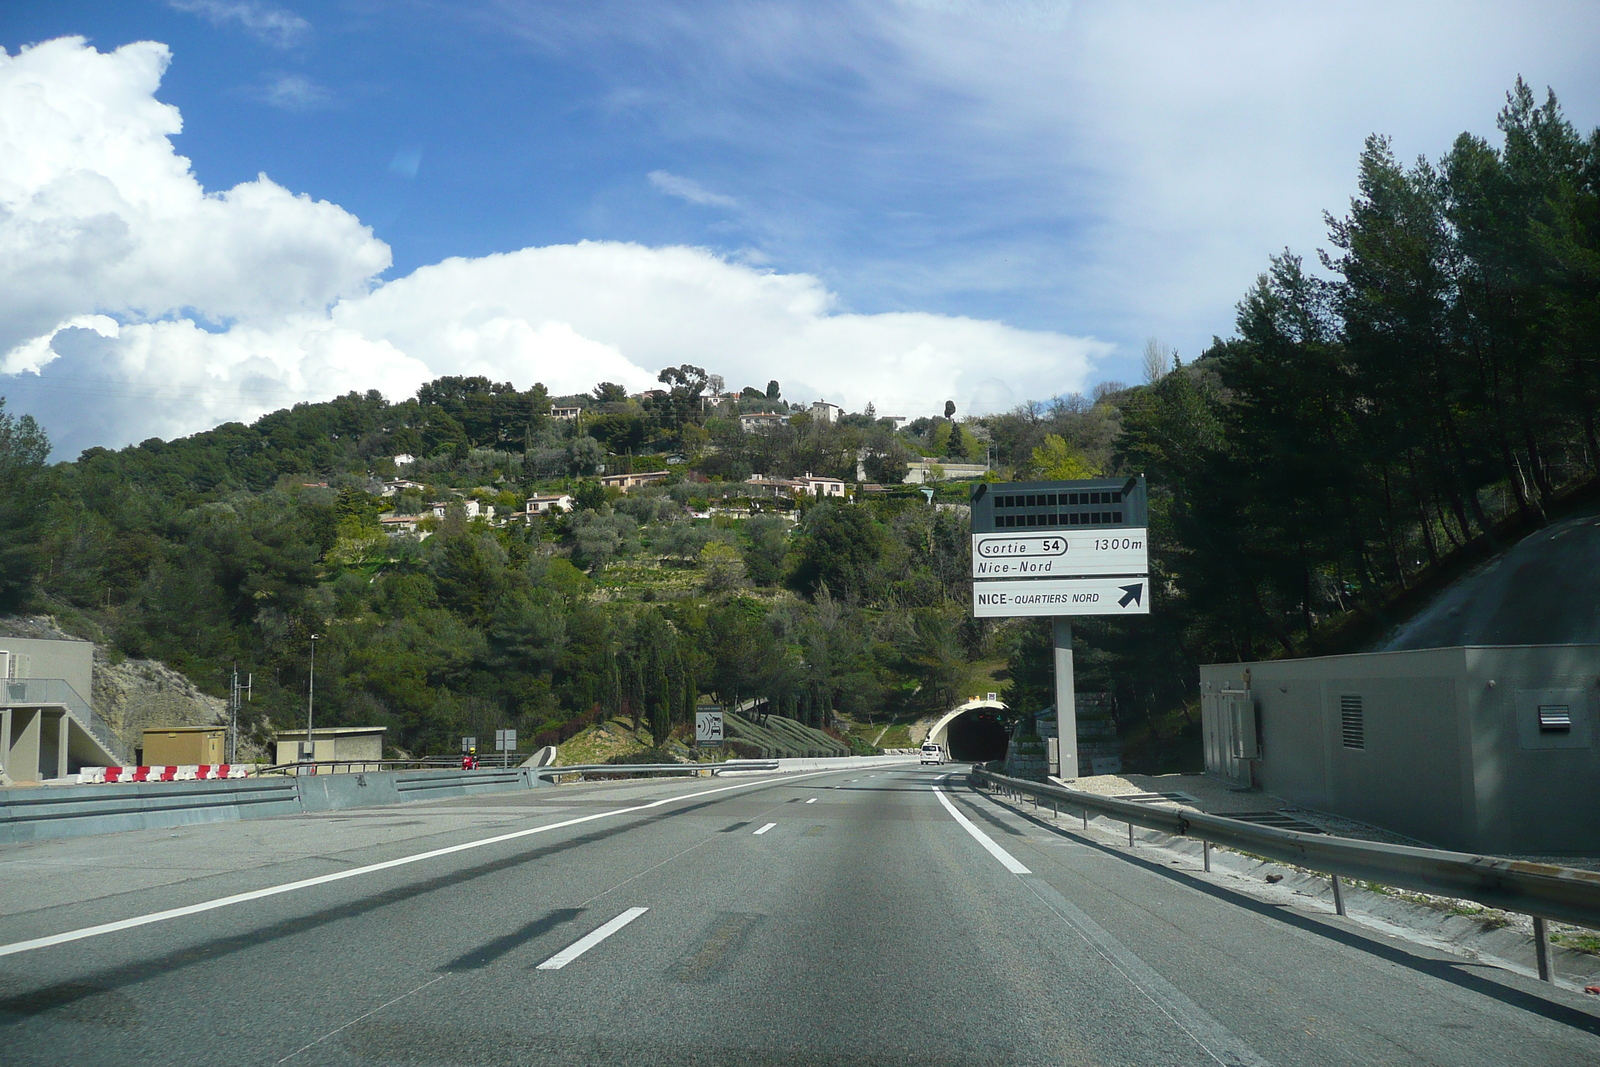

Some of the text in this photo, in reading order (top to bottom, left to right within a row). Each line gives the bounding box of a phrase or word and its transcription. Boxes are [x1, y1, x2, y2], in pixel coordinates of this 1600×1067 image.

[984, 540, 1060, 554] sortie 54
[1094, 538, 1142, 550] 1300m
[977, 560, 1053, 574] Nice-Nord
[1071, 593, 1100, 603] NORD
